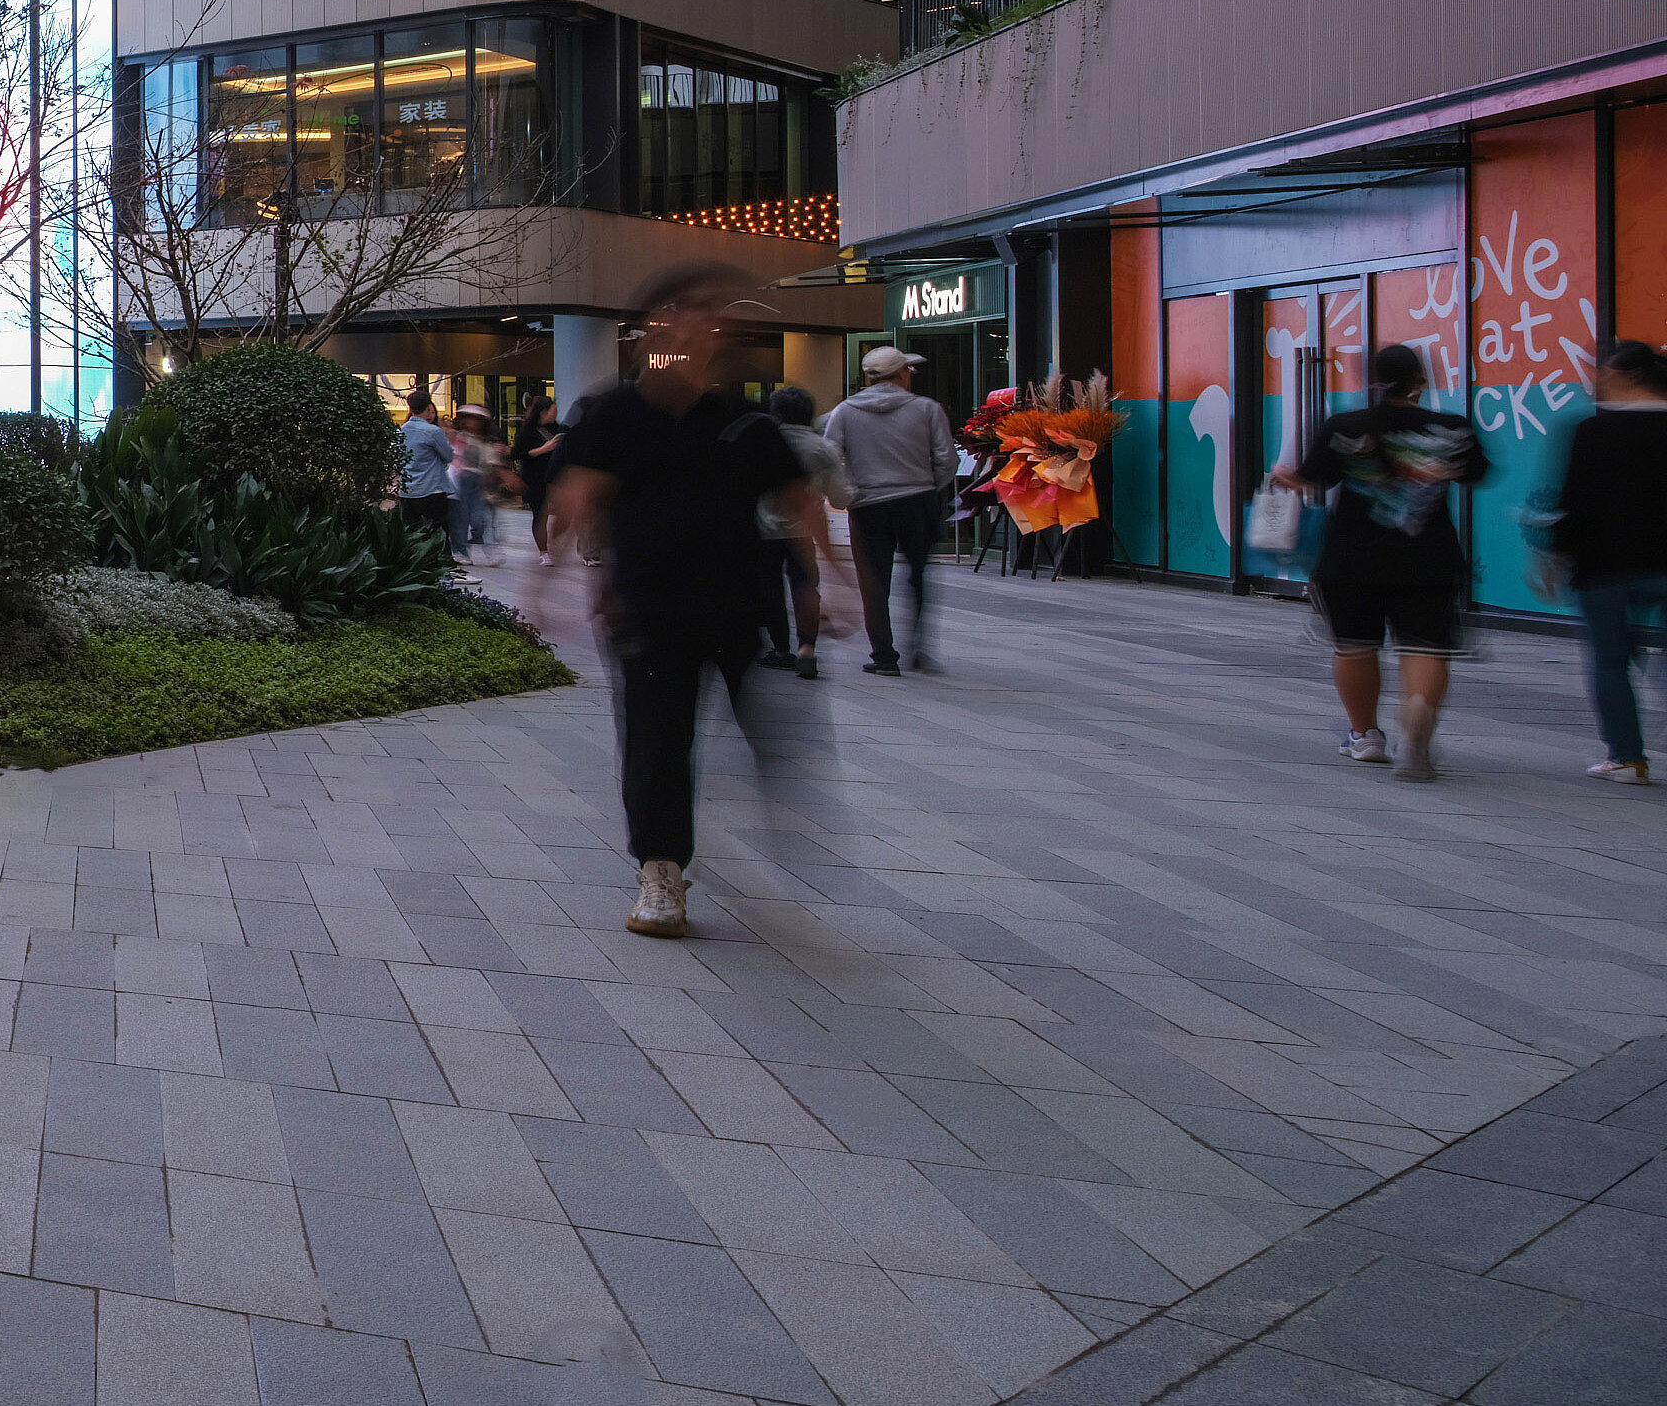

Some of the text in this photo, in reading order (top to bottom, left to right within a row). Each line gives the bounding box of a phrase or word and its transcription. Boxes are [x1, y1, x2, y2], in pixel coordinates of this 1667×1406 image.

[398, 99, 449, 125] 家装
[901, 275, 965, 321] M Stand
